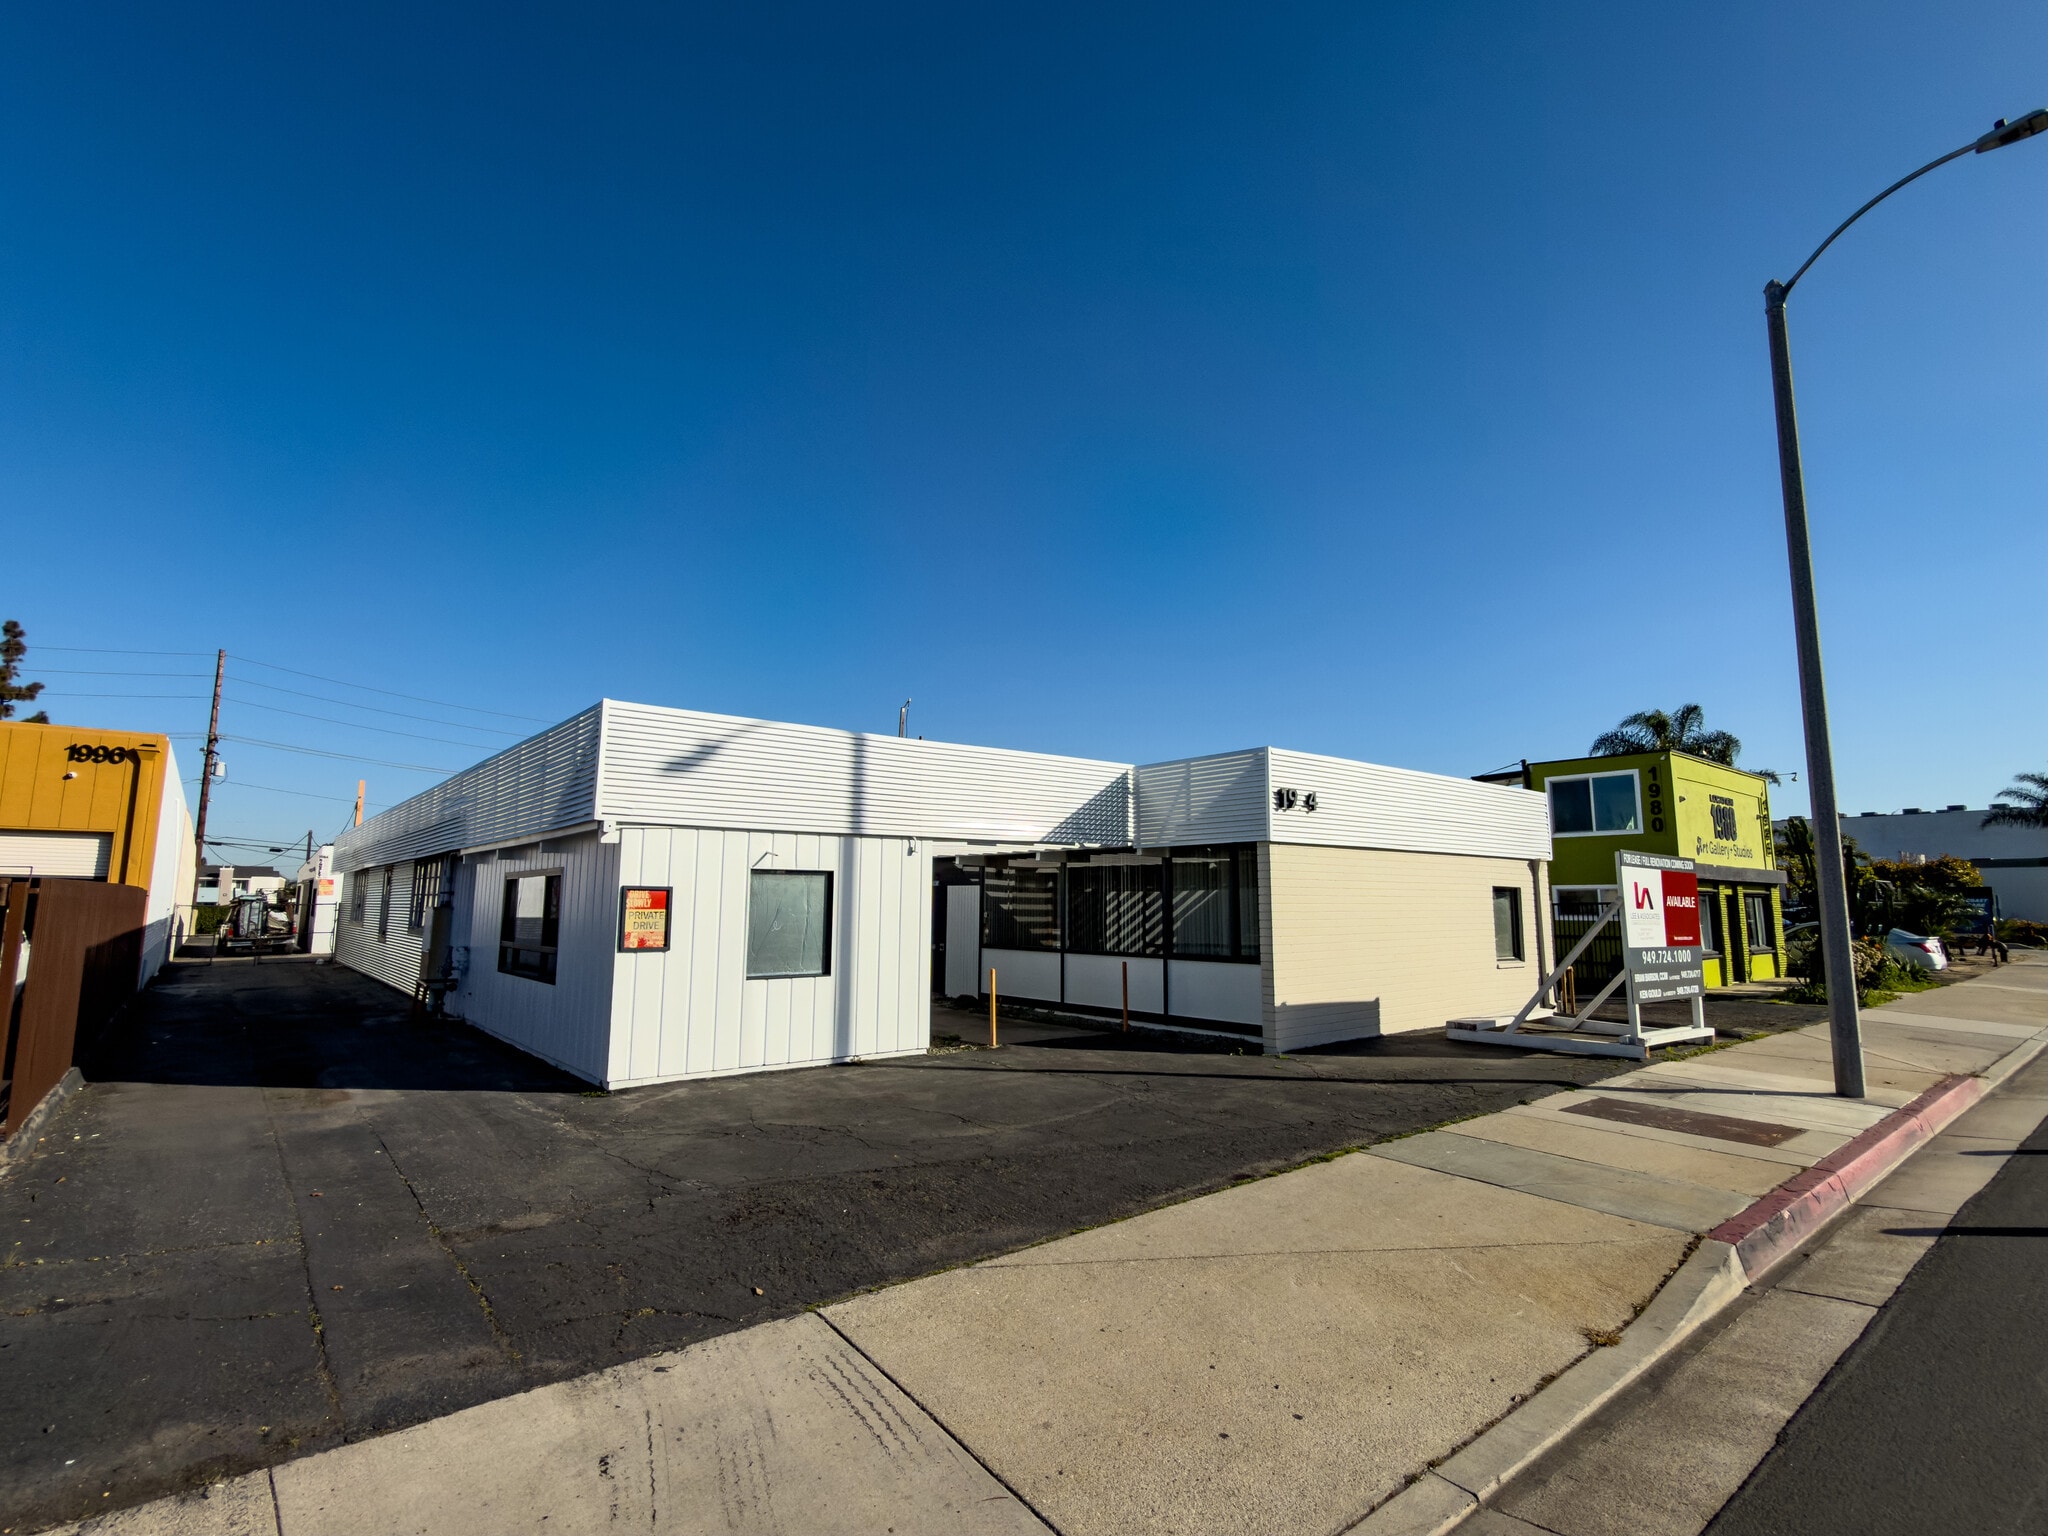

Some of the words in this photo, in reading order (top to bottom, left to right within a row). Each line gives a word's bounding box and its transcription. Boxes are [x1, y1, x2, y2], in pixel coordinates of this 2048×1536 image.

[64, 744, 127, 765] 1996
[1647, 766, 1664, 833] 1980
[1710, 803, 1738, 841] 1980
[1709, 841, 1730, 860] Gallery
[1733, 844, 1753, 859] Studios
[1666, 896, 1696, 908] AVAILABLE
[628, 911, 665, 920] PRIVATE
[633, 921, 660, 930] DRIVE
[1641, 949, 1691, 964] 949.724.1000
